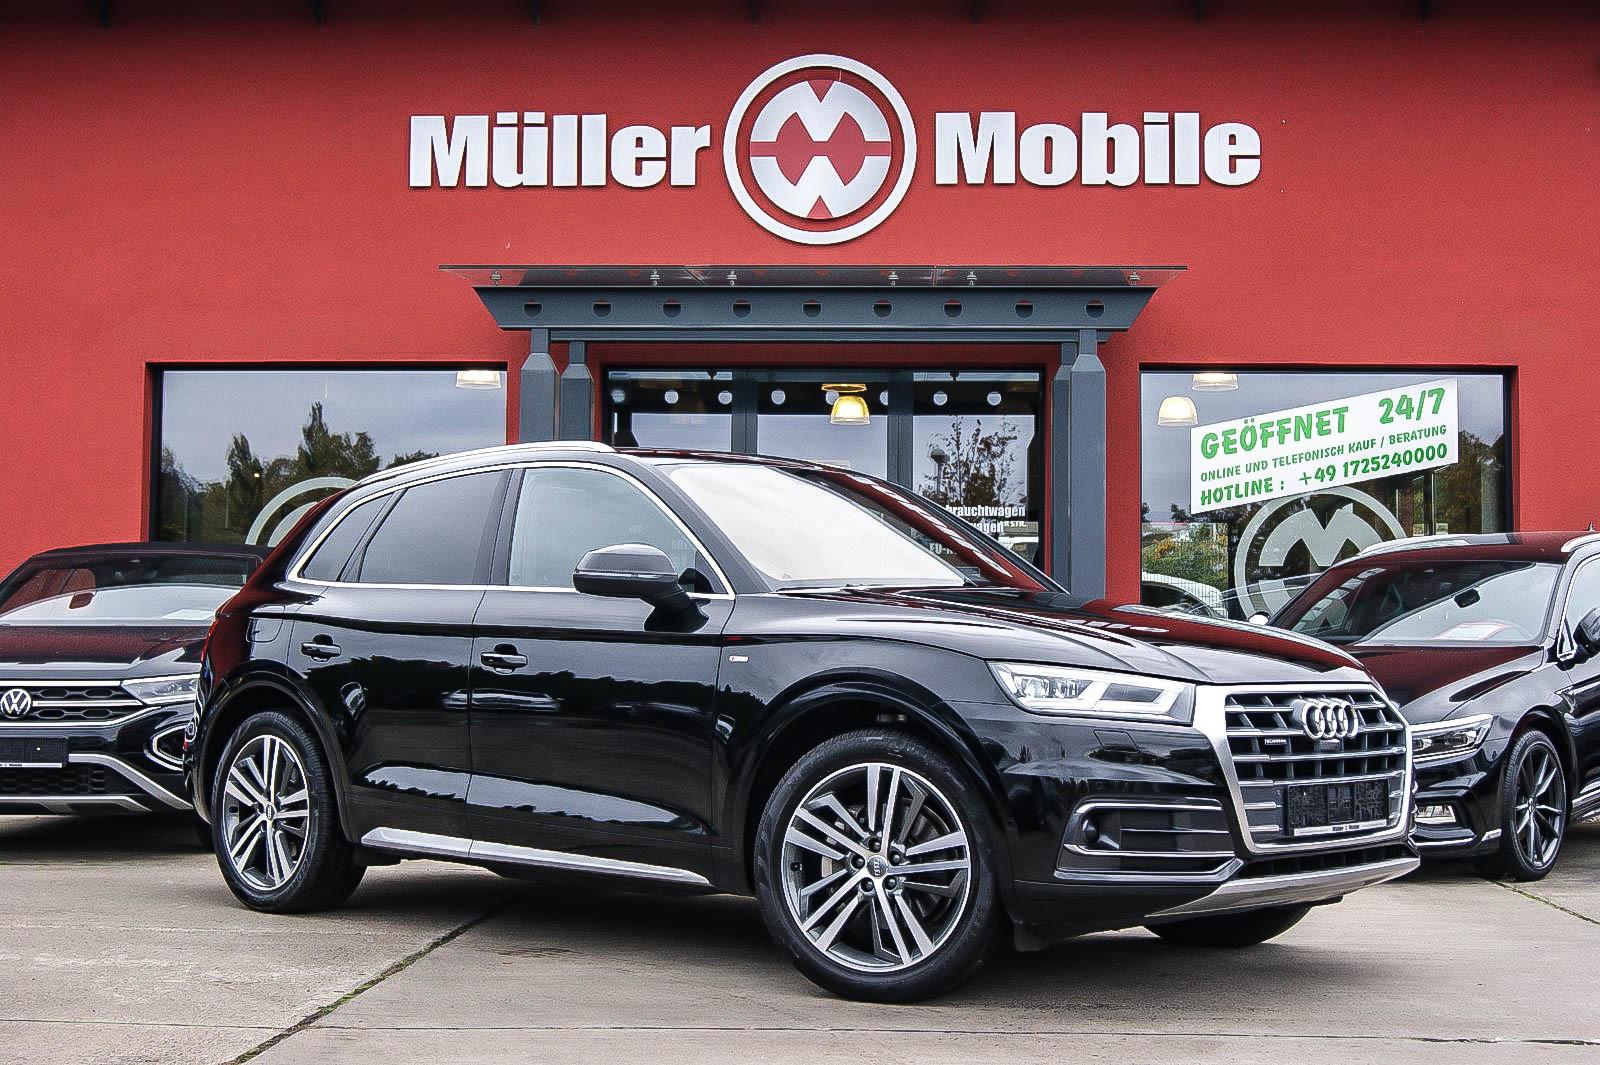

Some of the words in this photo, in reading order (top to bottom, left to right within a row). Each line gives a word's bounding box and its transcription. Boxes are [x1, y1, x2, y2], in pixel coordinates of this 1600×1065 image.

[409, 111, 711, 188] Müller
[935, 111, 1261, 187] Mobile
[1200, 465, 1241, 482] ONLINE
[1245, 460, 1269, 474] UND
[1271, 445, 1345, 469] TELEFONISCH
[1348, 438, 1377, 454] KAUF
[1388, 424, 1447, 445] BERATUNG
[1201, 406, 1349, 460] GEÖFFNET
[1378, 387, 1446, 425] 24/7
[1200, 476, 1274, 506] HOTLINE
[1298, 464, 1337, 485] +49
[1342, 442, 1448, 478] 1725240000
